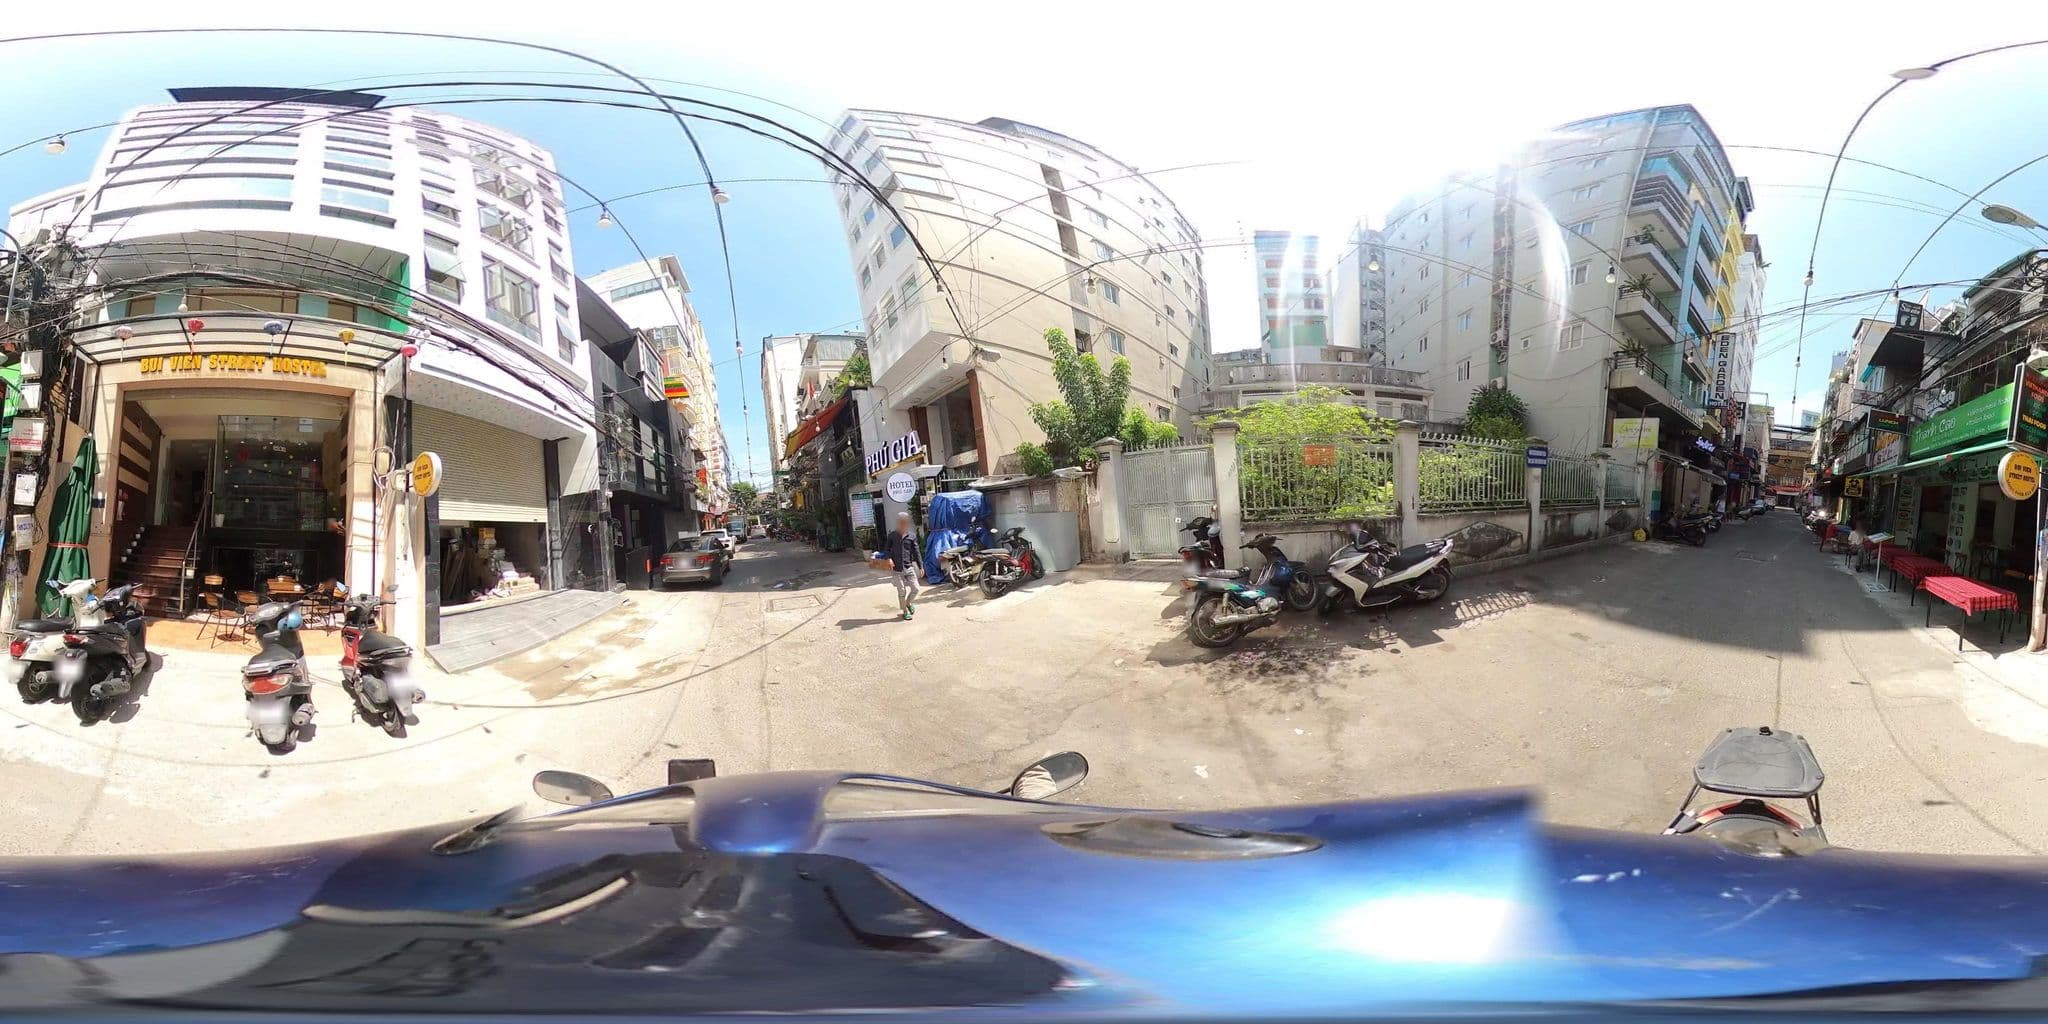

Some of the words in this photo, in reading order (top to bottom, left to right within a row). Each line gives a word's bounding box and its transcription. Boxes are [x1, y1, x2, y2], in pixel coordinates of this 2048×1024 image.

[1719, 335, 1730, 359] EDEN
[140, 356, 164, 373] BUI
[170, 355, 202, 371] VIEN
[208, 354, 266, 372] STREET
[272, 356, 327, 378] HOSTEL
[865, 441, 890, 475] PHÚ
[891, 430, 922, 463] GIA
[889, 480, 914, 490] HOTEL
